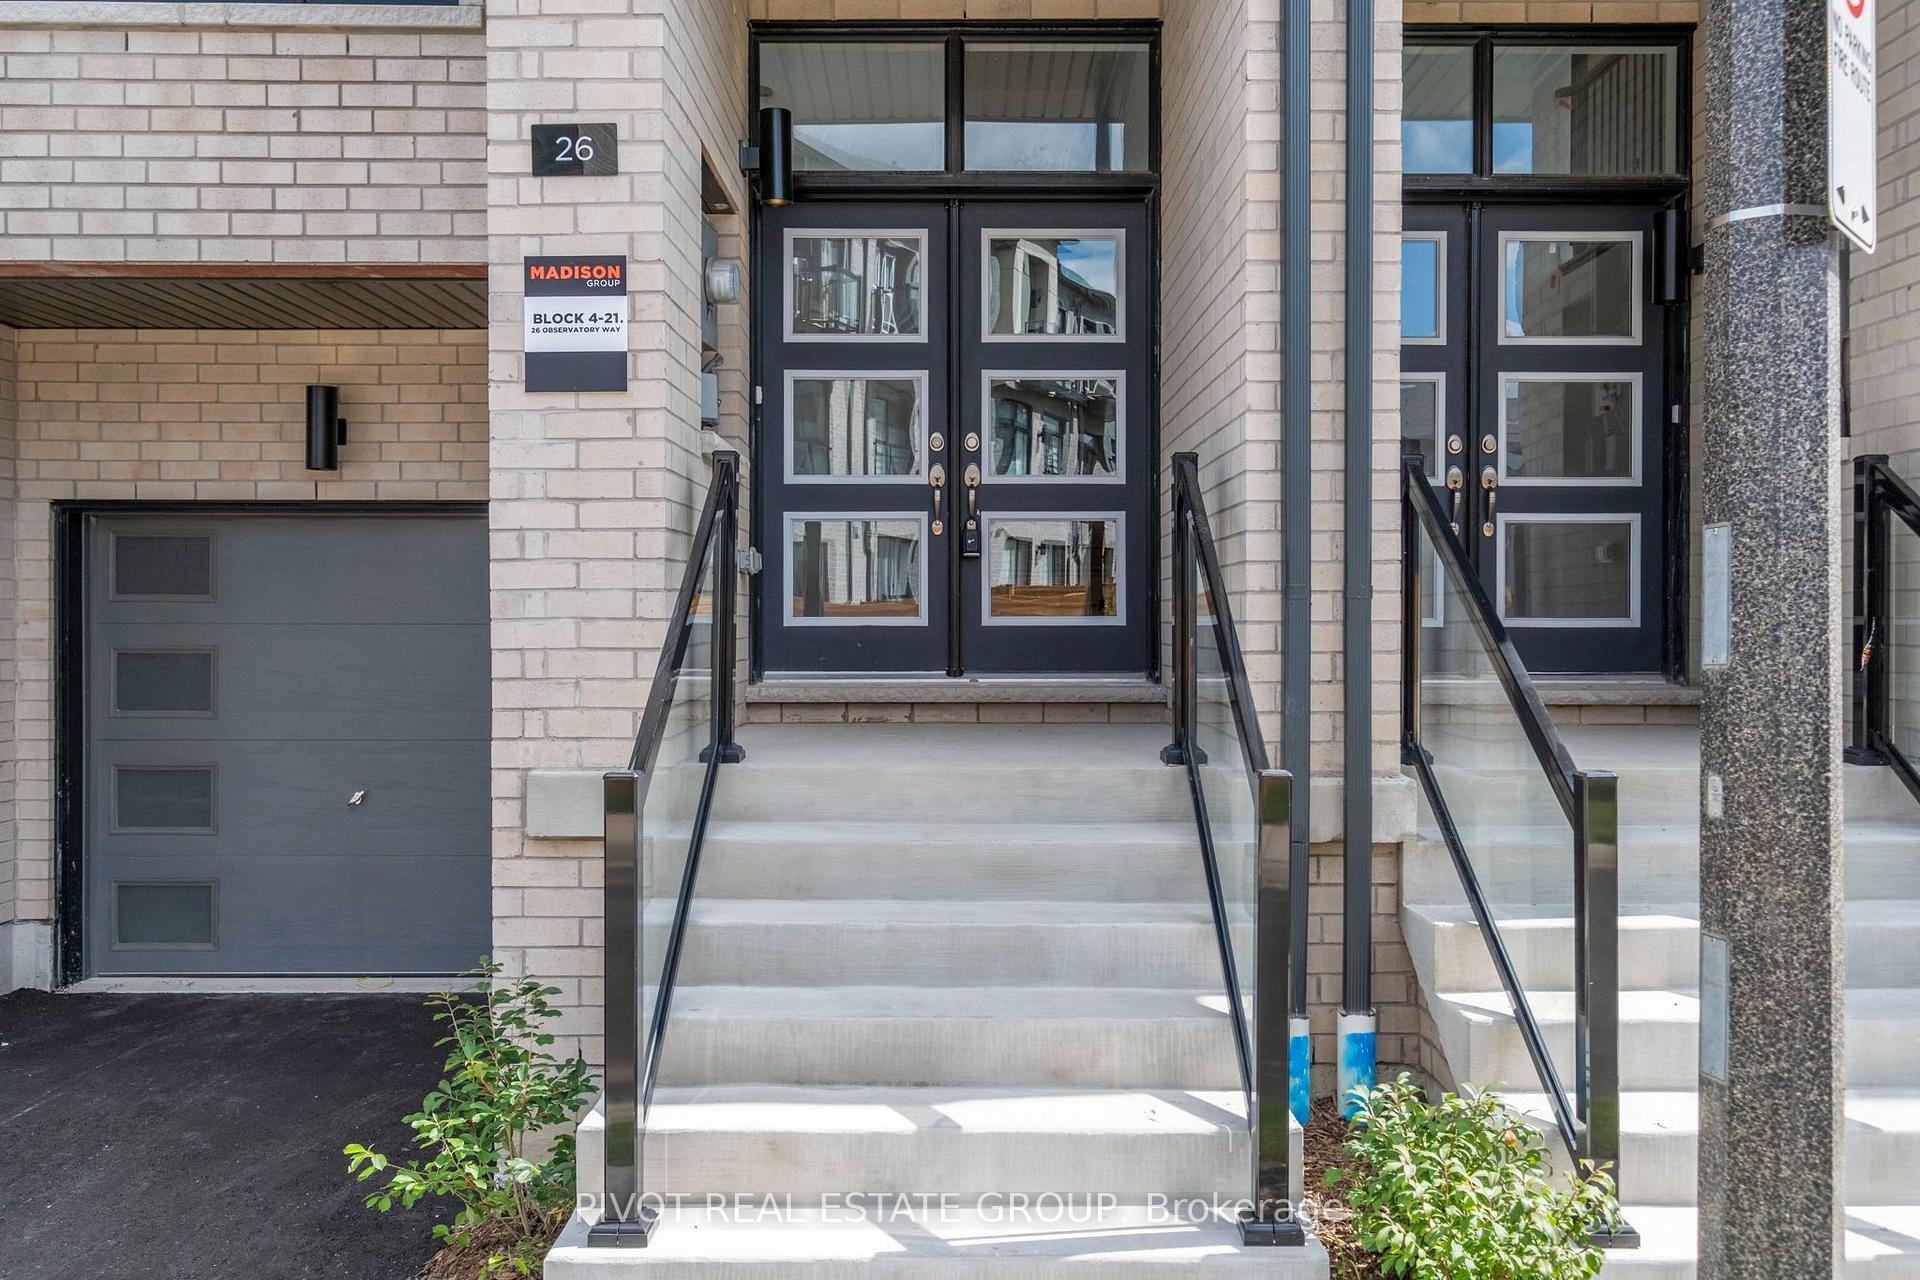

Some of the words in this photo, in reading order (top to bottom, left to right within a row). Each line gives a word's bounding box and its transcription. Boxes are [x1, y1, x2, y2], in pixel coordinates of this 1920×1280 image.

[555, 136, 594, 161] 26
[530, 265, 620, 279] MADISON
[586, 279, 620, 287] GROUP
[533, 313, 584, 324] BLOCK
[588, 312, 624, 324] 4-21.
